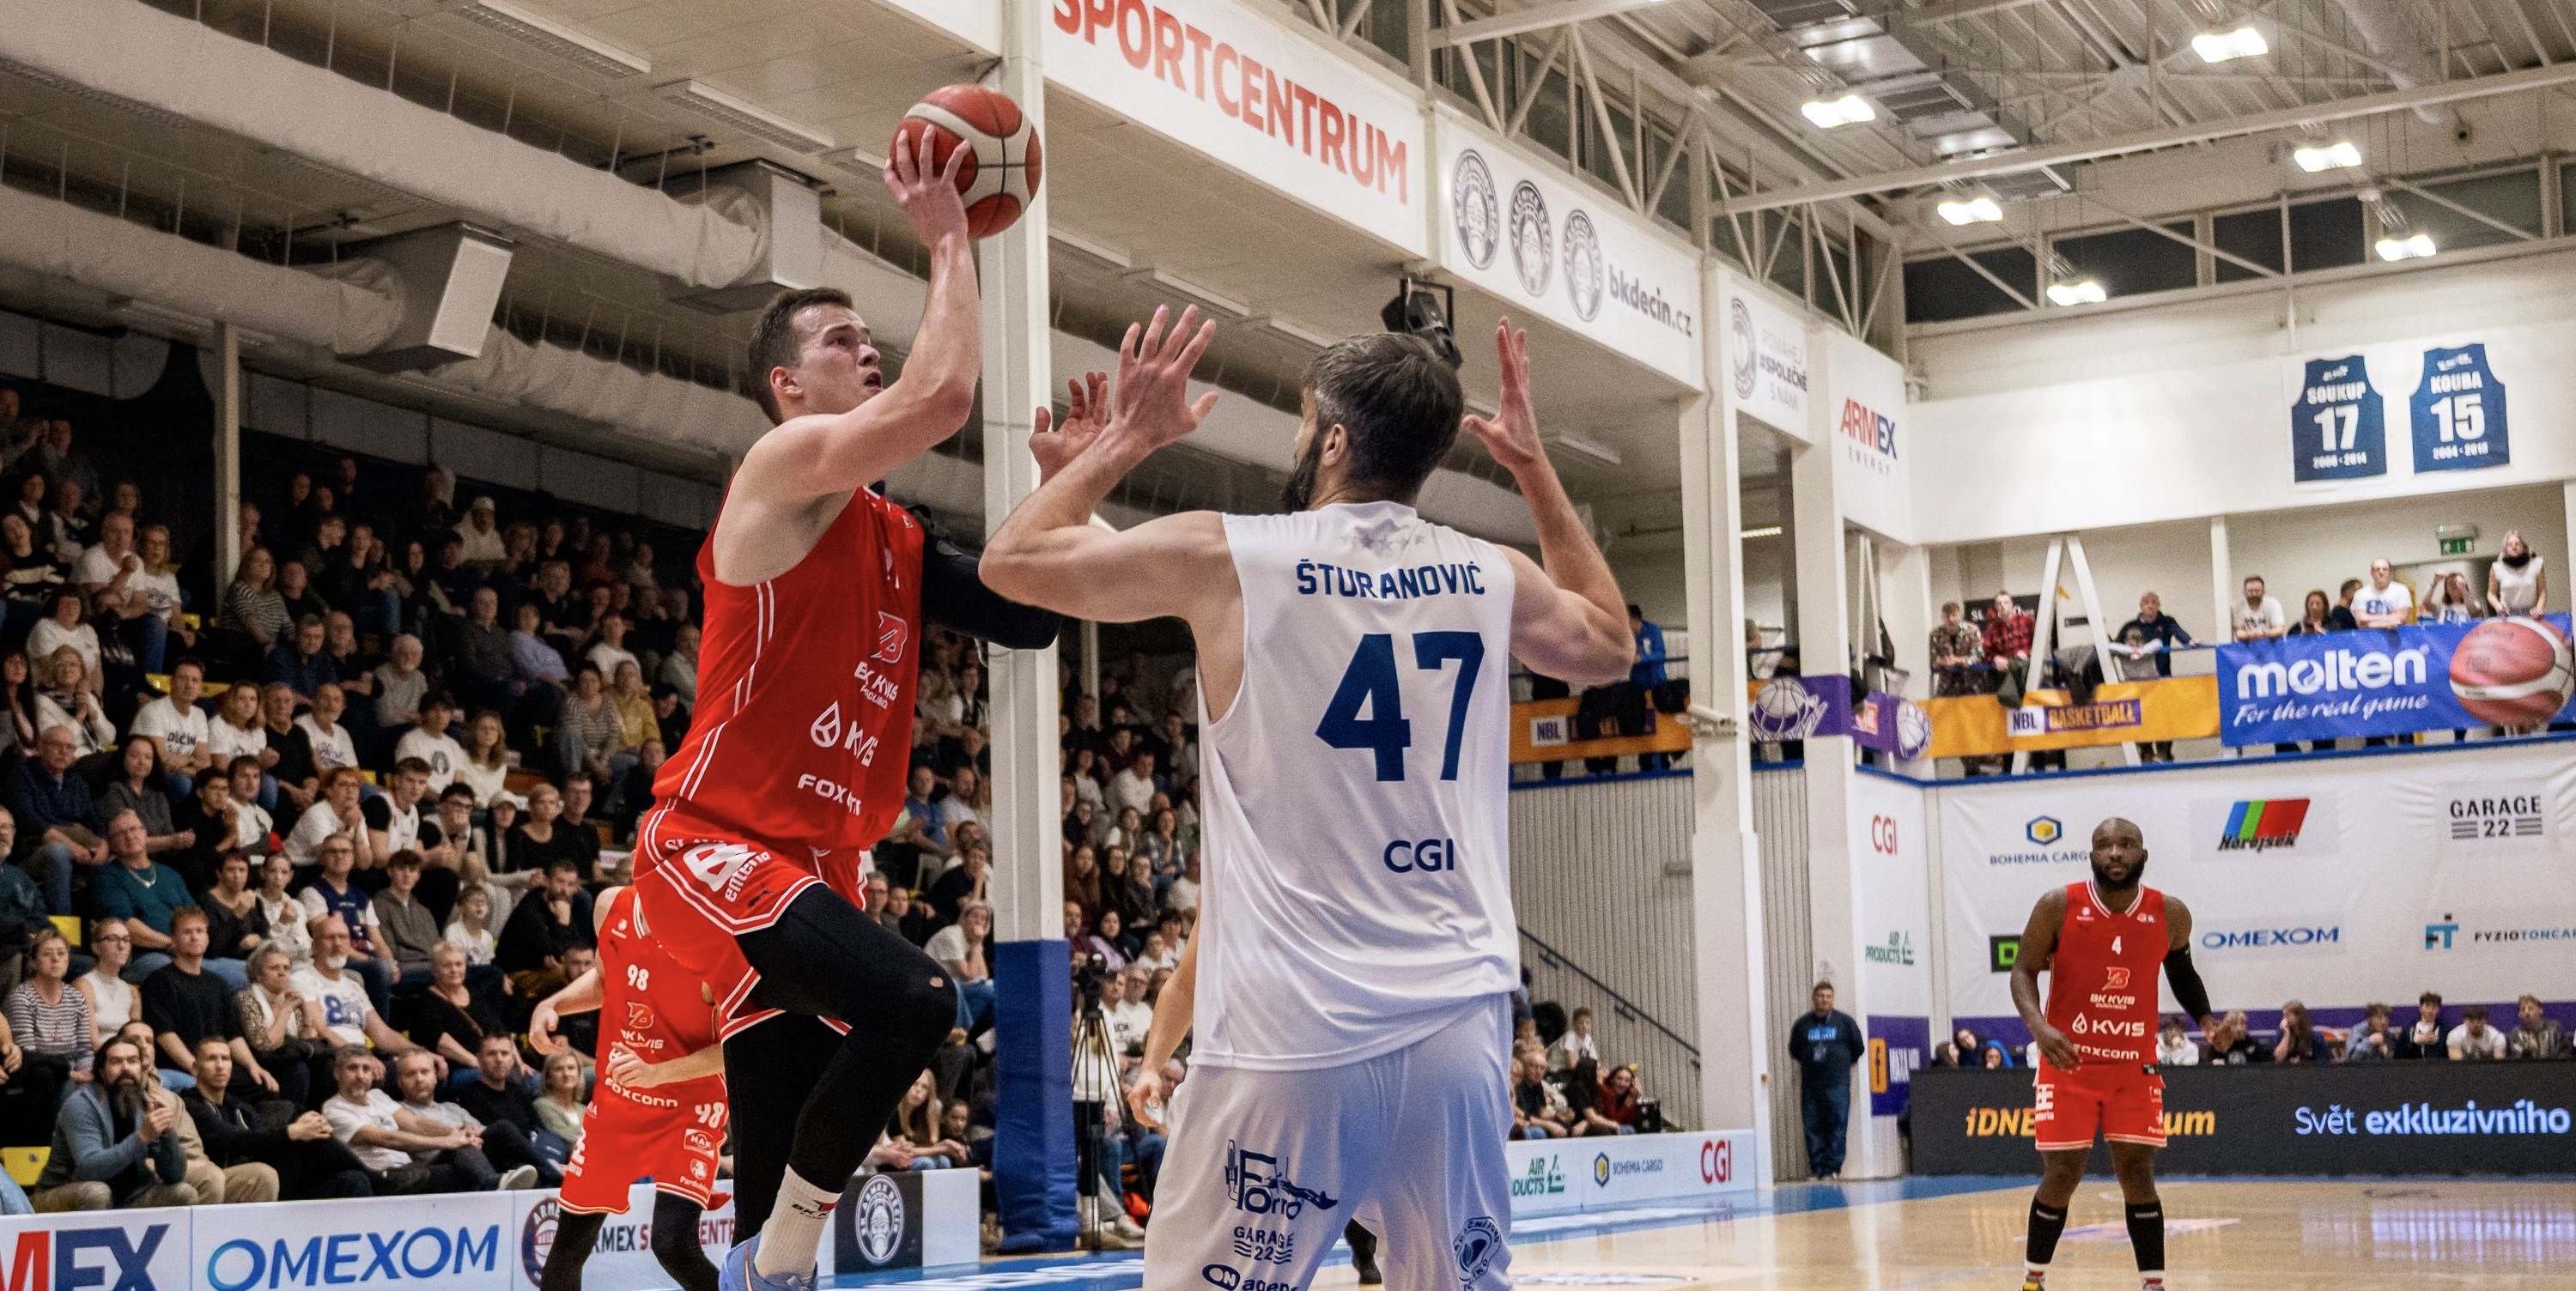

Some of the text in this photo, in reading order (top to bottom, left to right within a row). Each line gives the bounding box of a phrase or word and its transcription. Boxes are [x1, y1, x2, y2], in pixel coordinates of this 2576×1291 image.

[1053, 0, 1409, 205] SPORTCENTRUM
[1608, 264, 1692, 338] bkdecin.cz
[2306, 381, 2366, 405] SOUKUP
[2430, 370, 2483, 394] KOUBA
[1840, 397, 1897, 460] ARMEX
[2313, 403, 2359, 452] 17
[2430, 392, 2486, 443] 15
[1296, 559, 1485, 600] ŠTURANOVIĆ
[2236, 648, 2427, 700] molten
[1315, 631, 1485, 783] 47
[2013, 701, 2135, 730] NBL BASKETBALL
[2233, 694, 2428, 728] For the real game
[1536, 720, 1559, 742] NBL
[2450, 794, 2542, 818] GARAGE
[1872, 814, 1899, 857] CGI
[2483, 819, 2511, 838] 22
[1383, 839, 1455, 874] CGI
[1990, 851, 2091, 865] BOHEMIA CARG
[2111, 935, 2122, 955] 4
[2202, 926, 2339, 950] OMEXOM
[1865, 945, 1900, 964] PRODUCTS
[627, 964, 649, 991] 98
[2092, 1019, 2146, 1038] KVIS
[1965, 1107, 2035, 1137] iDNE
[2294, 1099, 2571, 1135] Svět exkluzivního
[1528, 1157, 1545, 1176] AIR
[1613, 1158, 1662, 1175] BOHEMIA CARGO
[1700, 1139, 1732, 1185] CGI
[1512, 1177, 1545, 1197] DUCTS
[596, 1224, 637, 1254] MEX
[1233, 1226, 1294, 1249] GARAGE
[208, 1224, 500, 1291] OMEXOM
[1254, 1246, 1274, 1261] 22
